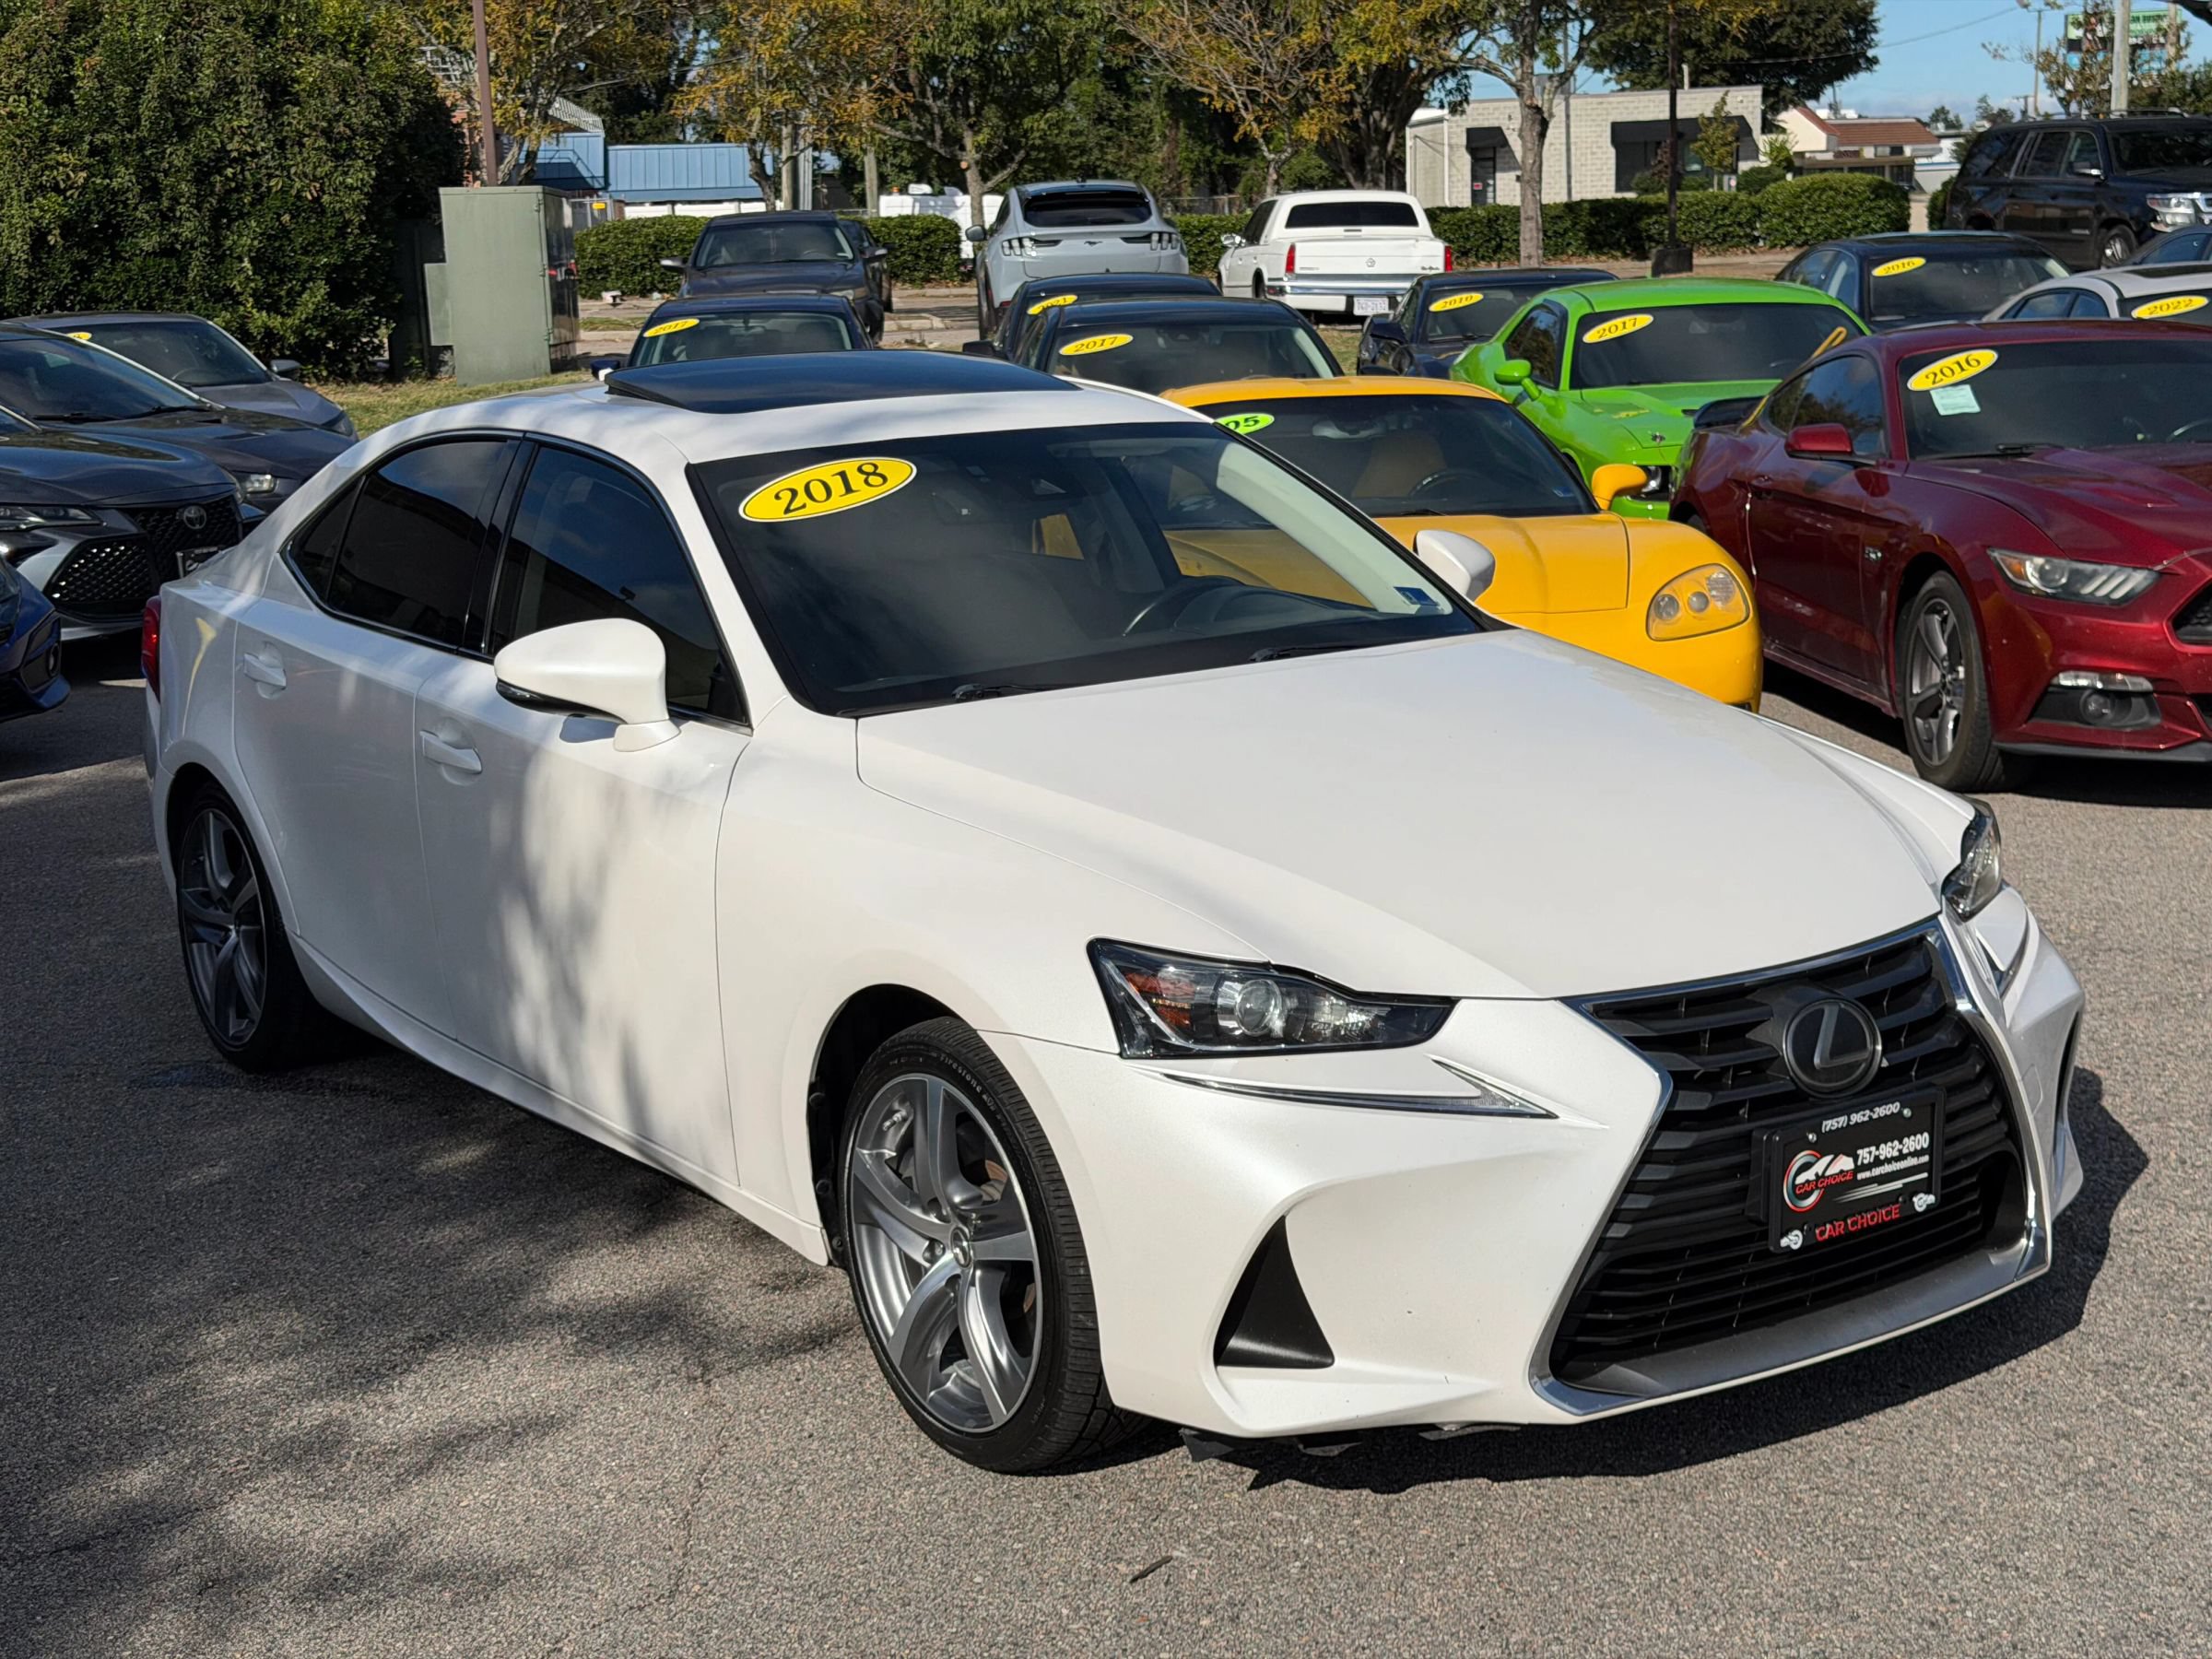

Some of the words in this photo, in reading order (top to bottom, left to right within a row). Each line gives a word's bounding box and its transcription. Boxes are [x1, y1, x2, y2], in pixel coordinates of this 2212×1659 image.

[2147, 298, 2194, 315] 2022
[1596, 317, 1638, 339] 2017
[1074, 336, 1119, 353] 2017
[1924, 353, 1982, 385] 2016
[773, 462, 888, 515] 2018
[1821, 1114, 1848, 1134] (757)
[1849, 1100, 1900, 1125] 962-2600
[1856, 1132, 1930, 1166] 757-962-2600
[1795, 1181, 1817, 1194] CAR
[1818, 1171, 1854, 1188] CHOICE
[1815, 1220, 1845, 1241] CAR
[1847, 1203, 1901, 1231] CHOICE
